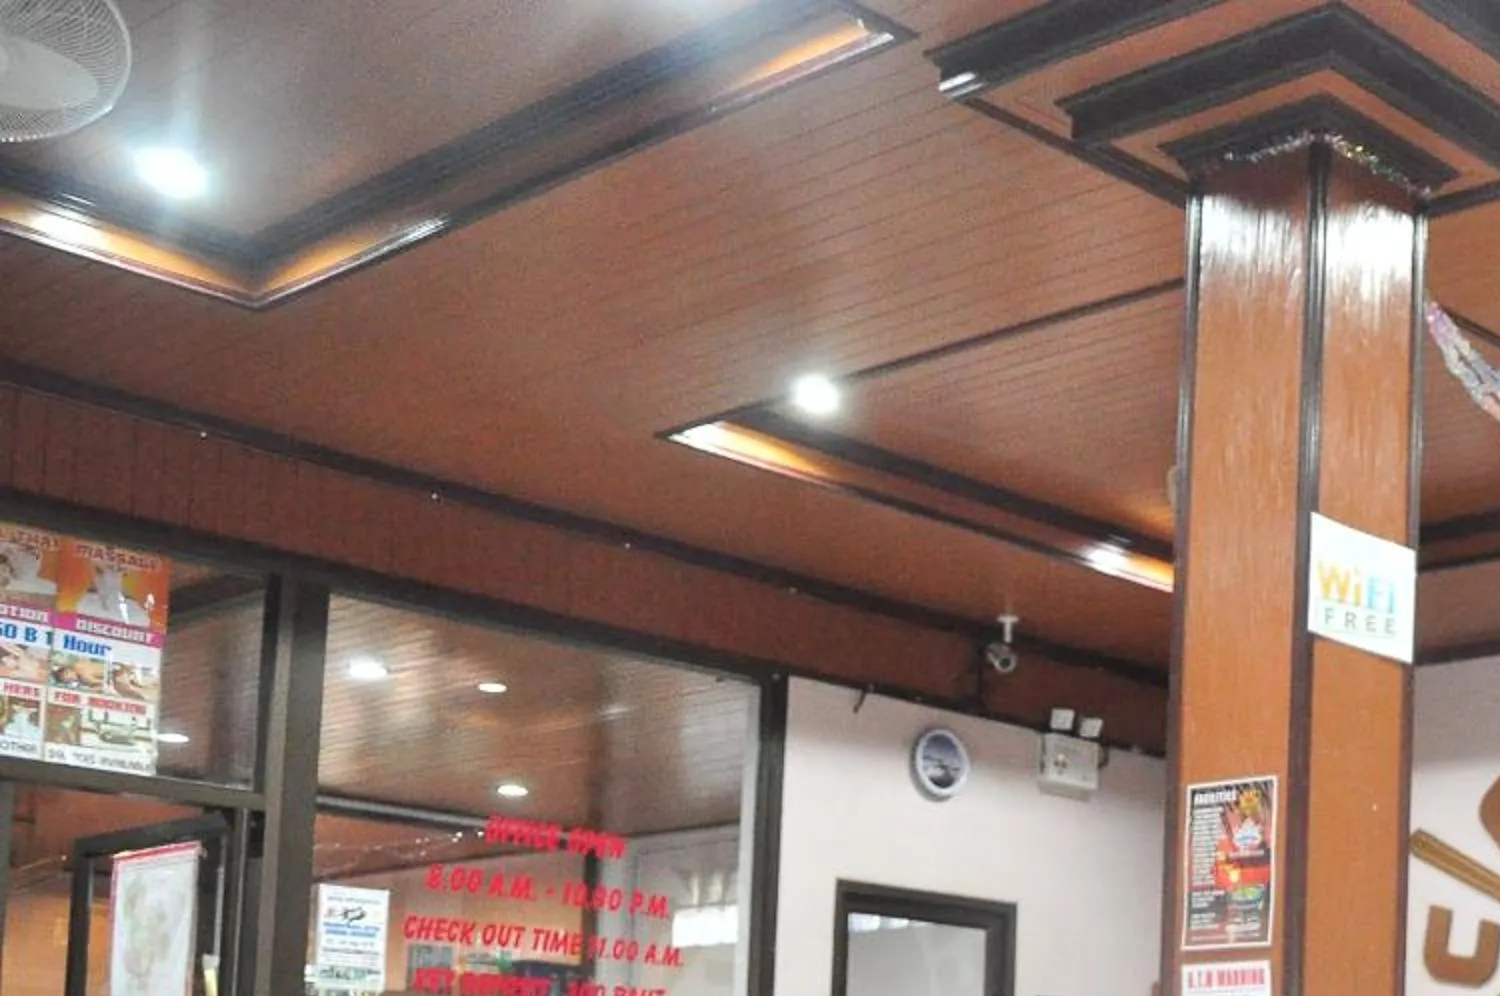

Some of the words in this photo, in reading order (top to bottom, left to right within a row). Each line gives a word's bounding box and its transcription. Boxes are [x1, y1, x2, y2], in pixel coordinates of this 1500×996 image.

[1324, 607, 1396, 635] FREE
[63, 634, 112, 656] Hour
[403, 914, 475, 945] CHECK
[482, 924, 526, 949] OUT
[532, 927, 584, 957] TIME
